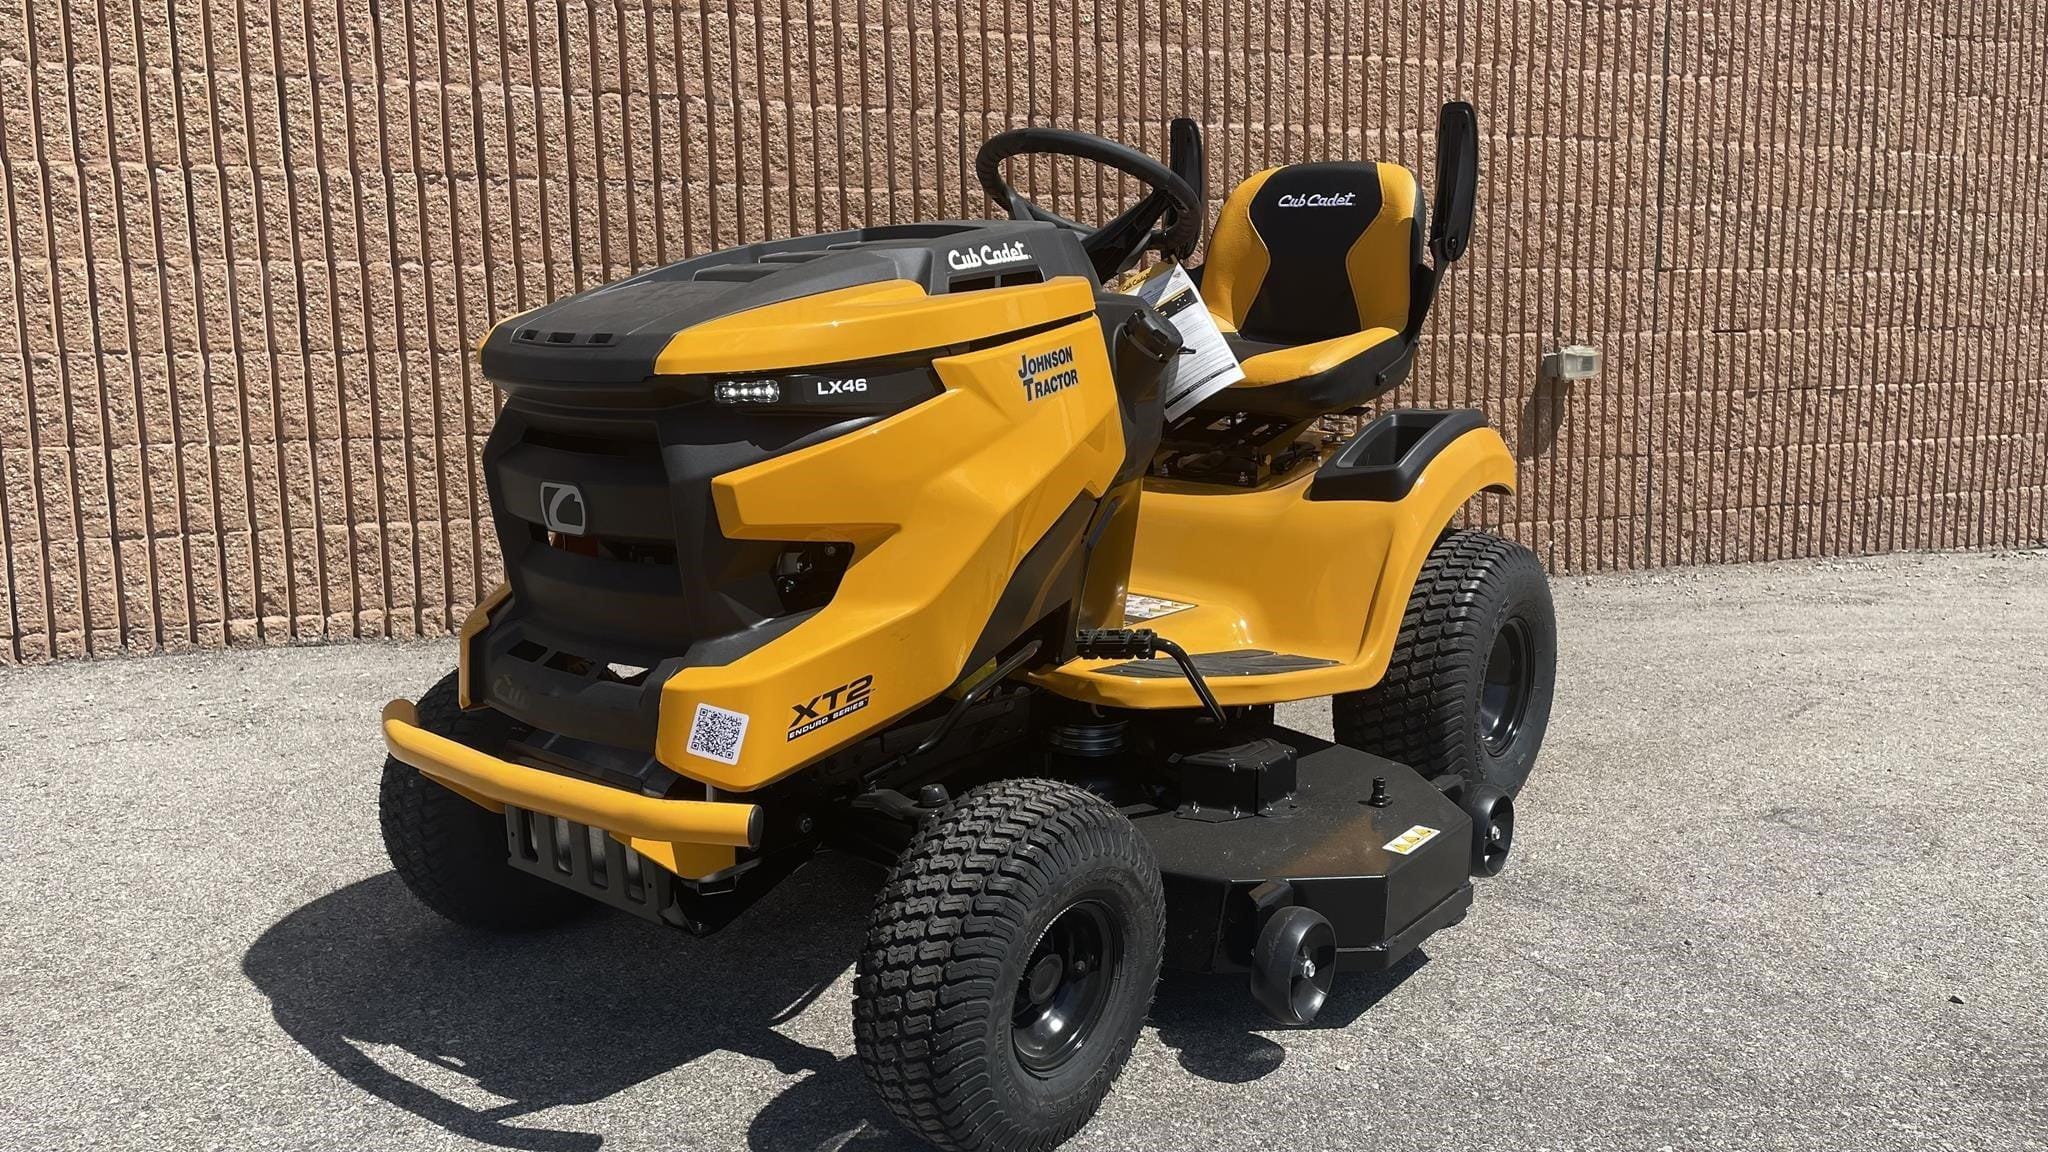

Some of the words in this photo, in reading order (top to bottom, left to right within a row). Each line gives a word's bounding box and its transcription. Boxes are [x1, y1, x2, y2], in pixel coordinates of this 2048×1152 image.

[1278, 193, 1306, 207] Cub
[1307, 192, 1356, 207] Cadet
[948, 247, 982, 270] Cub
[980, 241, 1032, 265] Cadet
[1018, 345, 1073, 379] JOHNSON
[817, 378, 867, 395] LX46
[1022, 368, 1079, 402] TRACTOR
[788, 674, 874, 729] XT2
[789, 716, 829, 739] ENDURO
[832, 700, 866, 719] SERIES
